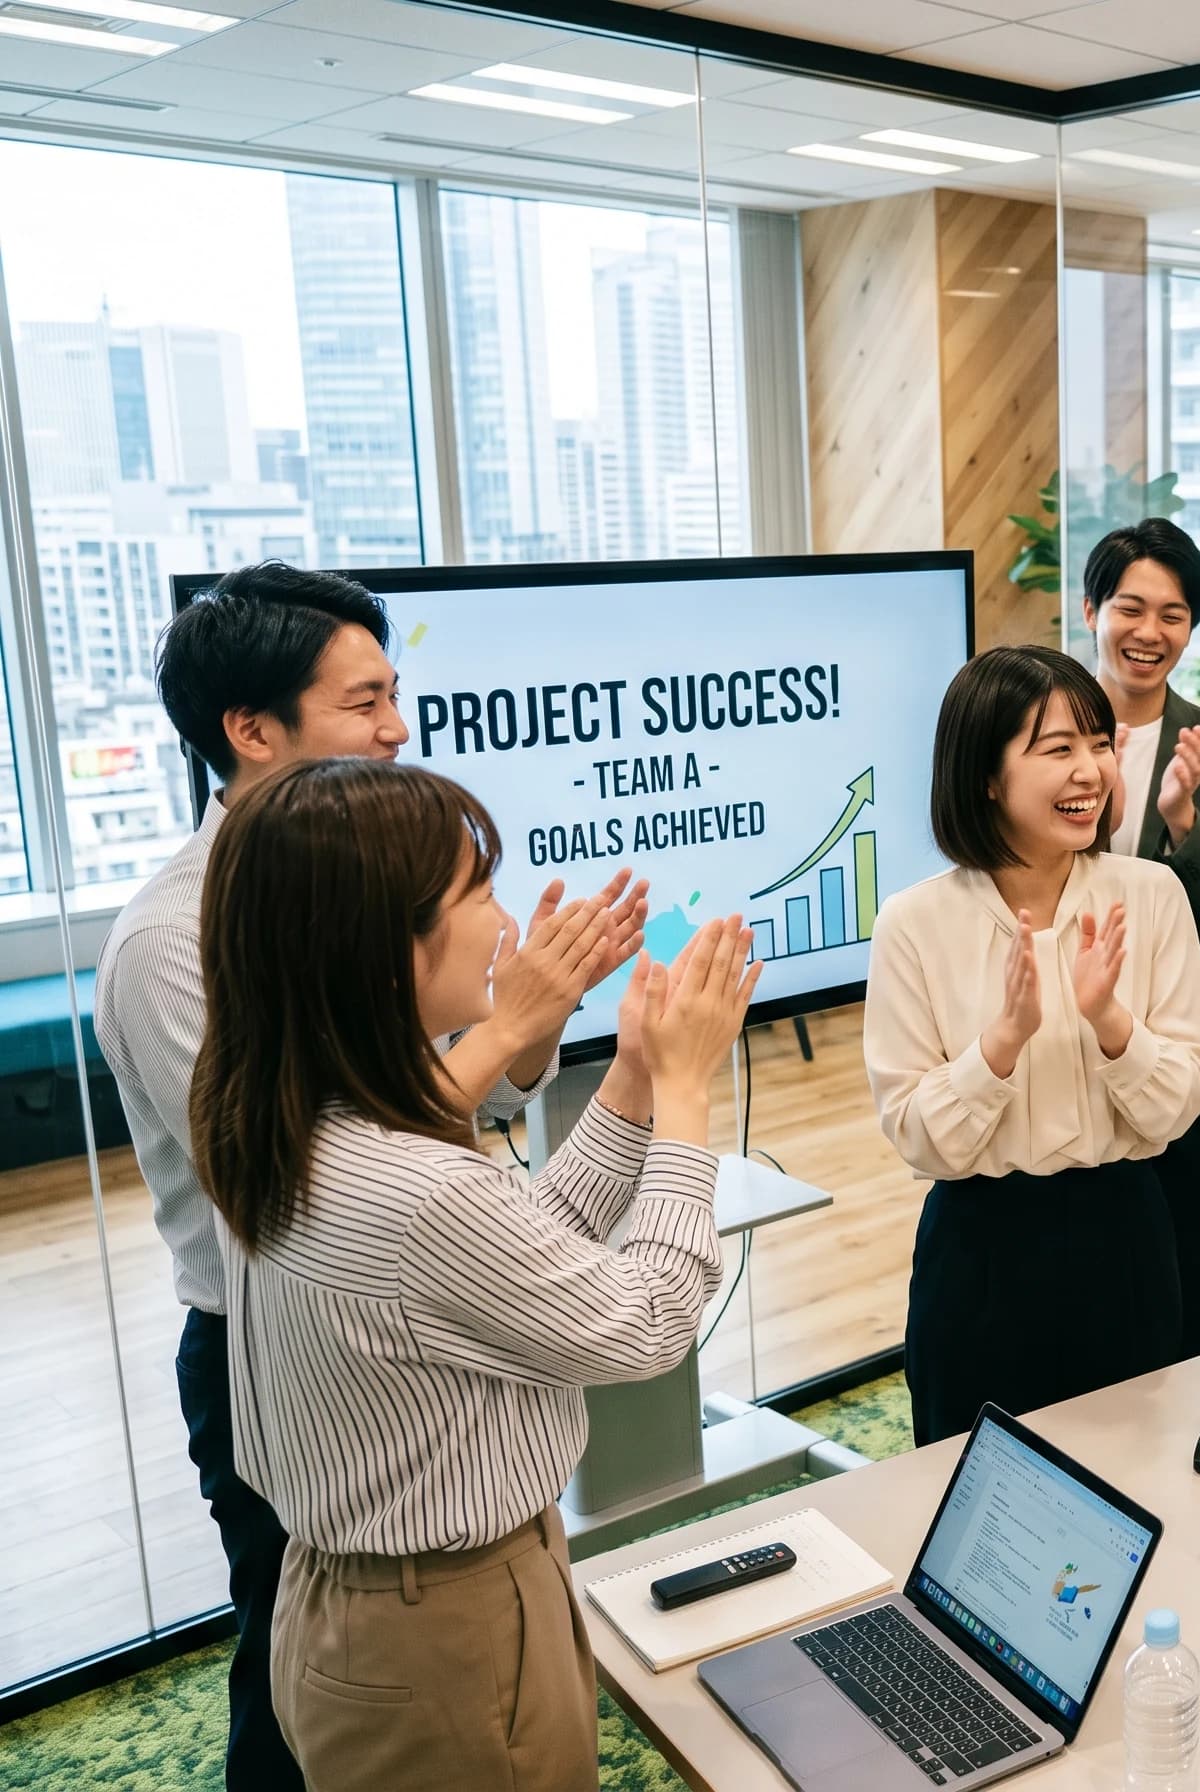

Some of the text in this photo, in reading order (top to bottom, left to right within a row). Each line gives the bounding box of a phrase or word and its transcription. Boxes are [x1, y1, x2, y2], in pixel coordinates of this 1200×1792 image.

[417, 663, 841, 758] PROJECT SUCCESS!
[592, 757, 674, 799] TEAM
[683, 752, 701, 790] A
[528, 801, 765, 867] GOALS ACHIEVED
